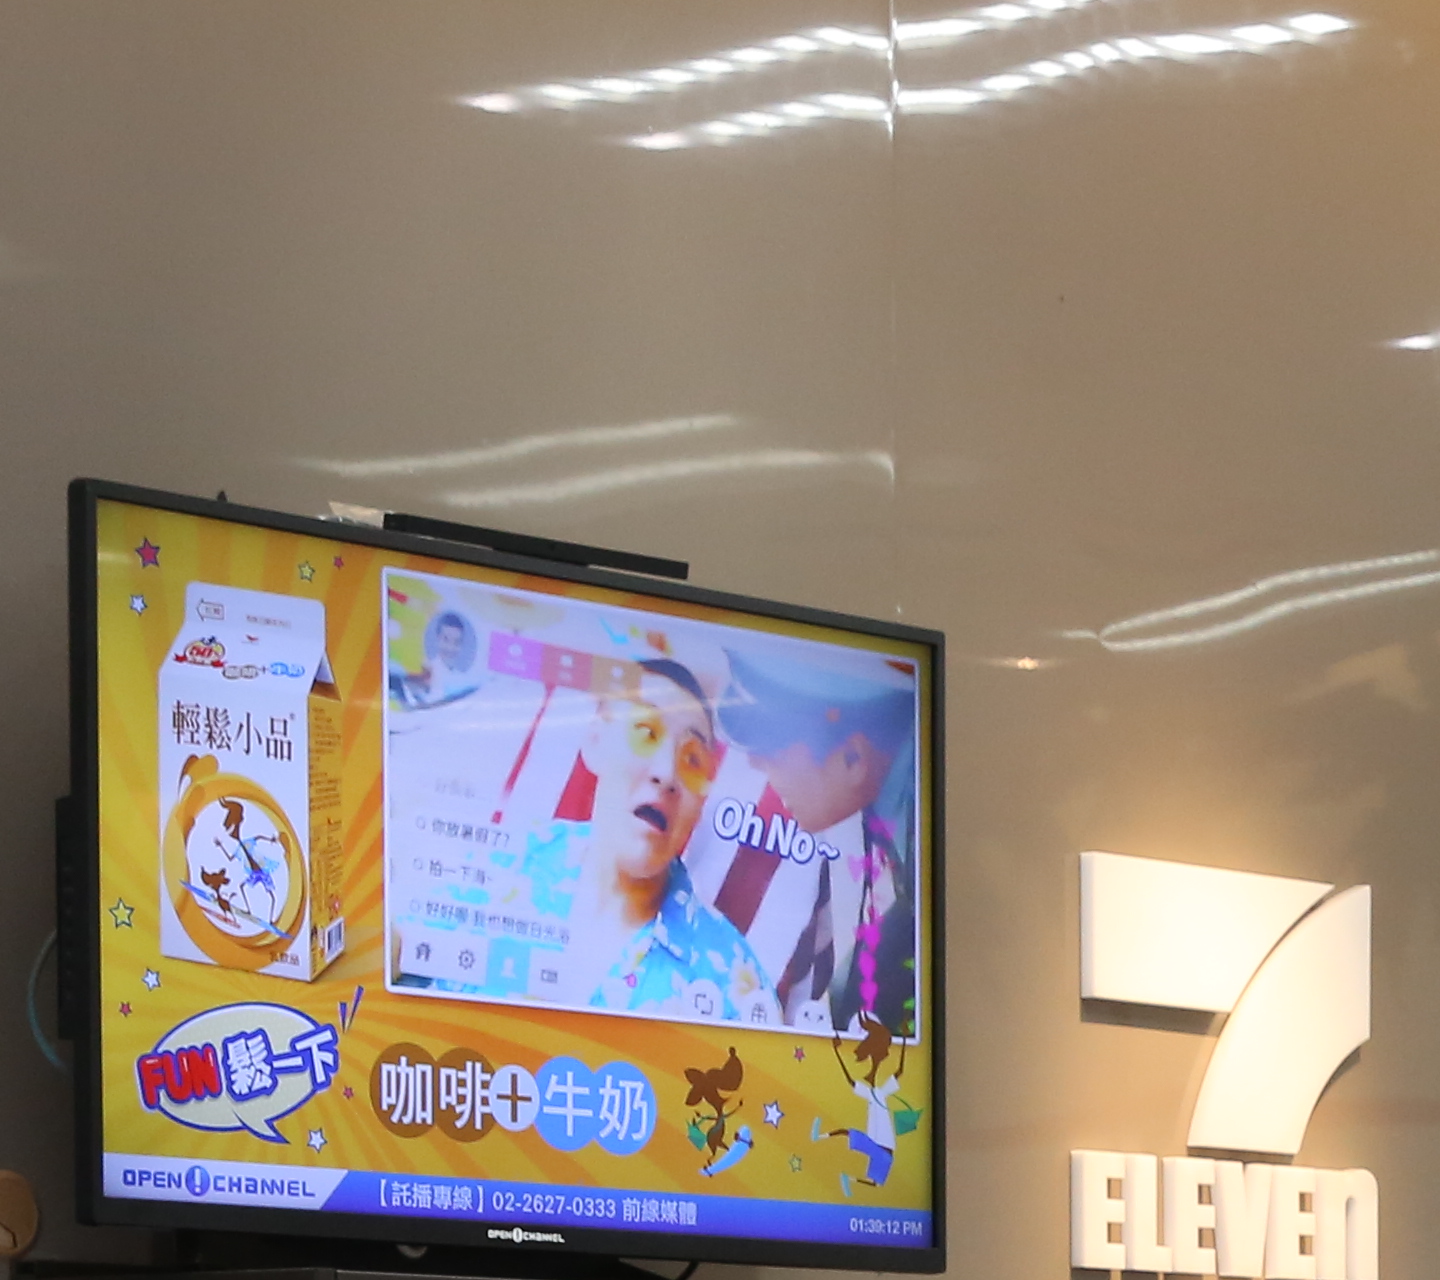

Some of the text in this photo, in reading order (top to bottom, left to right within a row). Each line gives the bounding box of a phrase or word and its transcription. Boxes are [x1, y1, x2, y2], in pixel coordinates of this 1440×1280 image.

[171, 699, 295, 763] 輕鬆小品
[713, 796, 763, 848] Oh
[137, 1022, 339, 1108] FUN 鬆一下
[491, 1189, 698, 1226] 02-2627-0333 前線媒體
[849, 1216, 923, 1237] 01:39:12 PM
